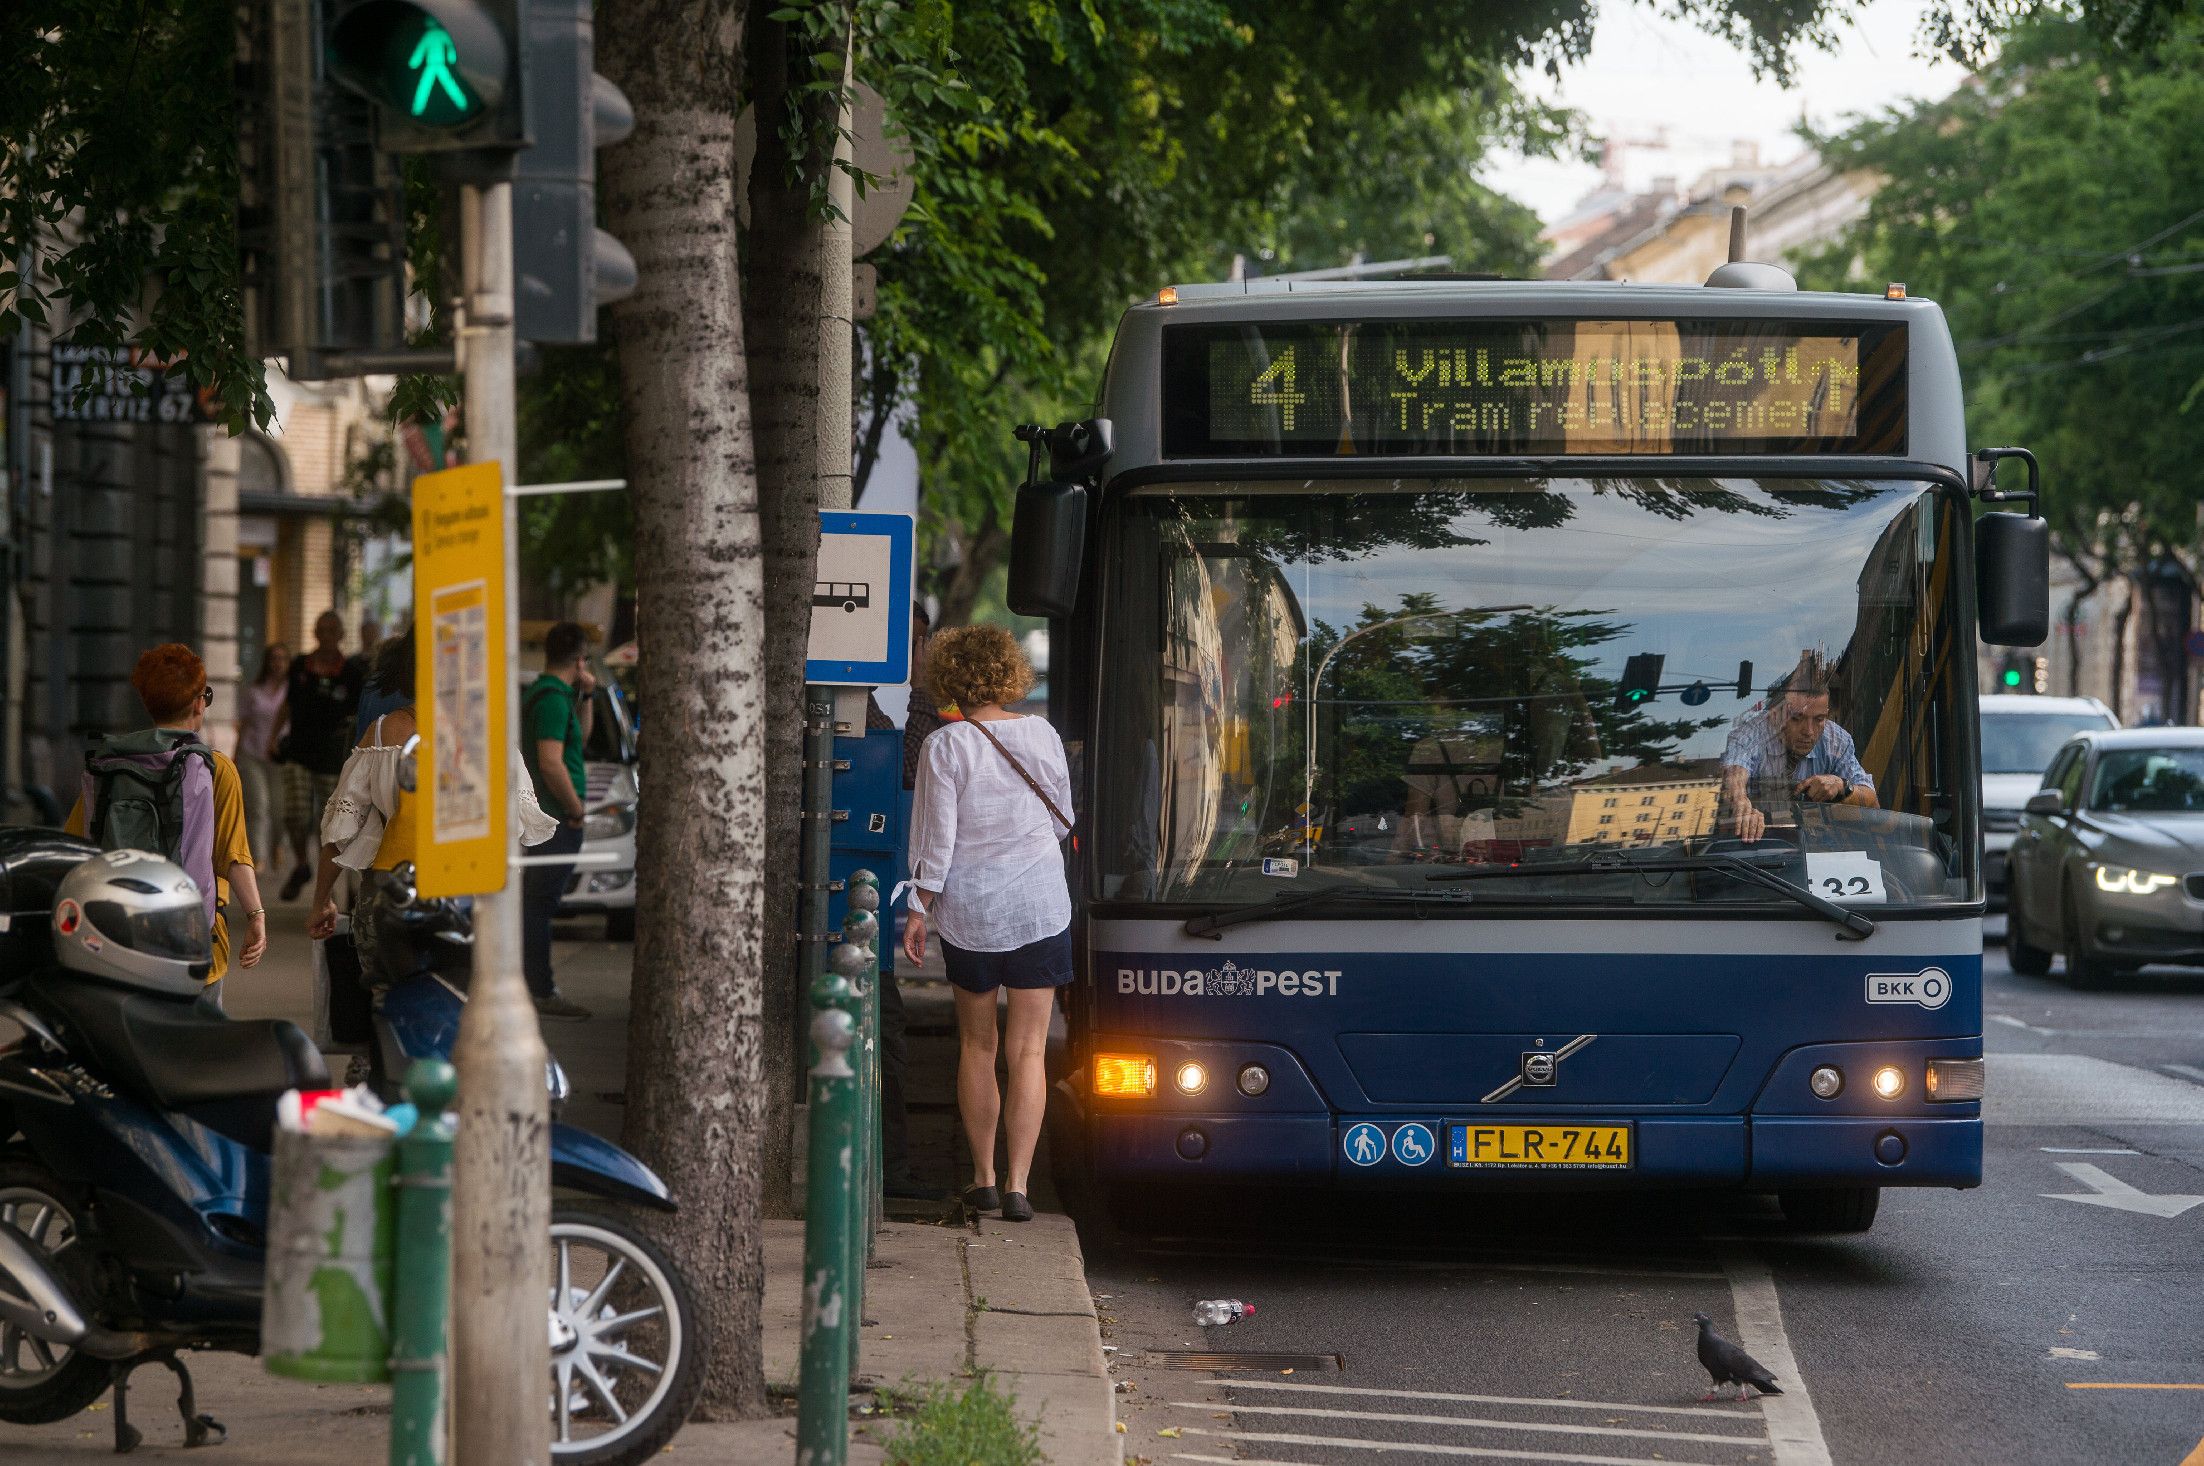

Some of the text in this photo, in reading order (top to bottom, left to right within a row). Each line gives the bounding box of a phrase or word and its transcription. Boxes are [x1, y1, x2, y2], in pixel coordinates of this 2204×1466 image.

[1251, 345, 1305, 431] 4
[1390, 392, 1511, 430] Tram
[1877, 982, 1915, 996] BKK
[1453, 1146, 1462, 1157] H
[1474, 1129, 1623, 1160] FLR-744
